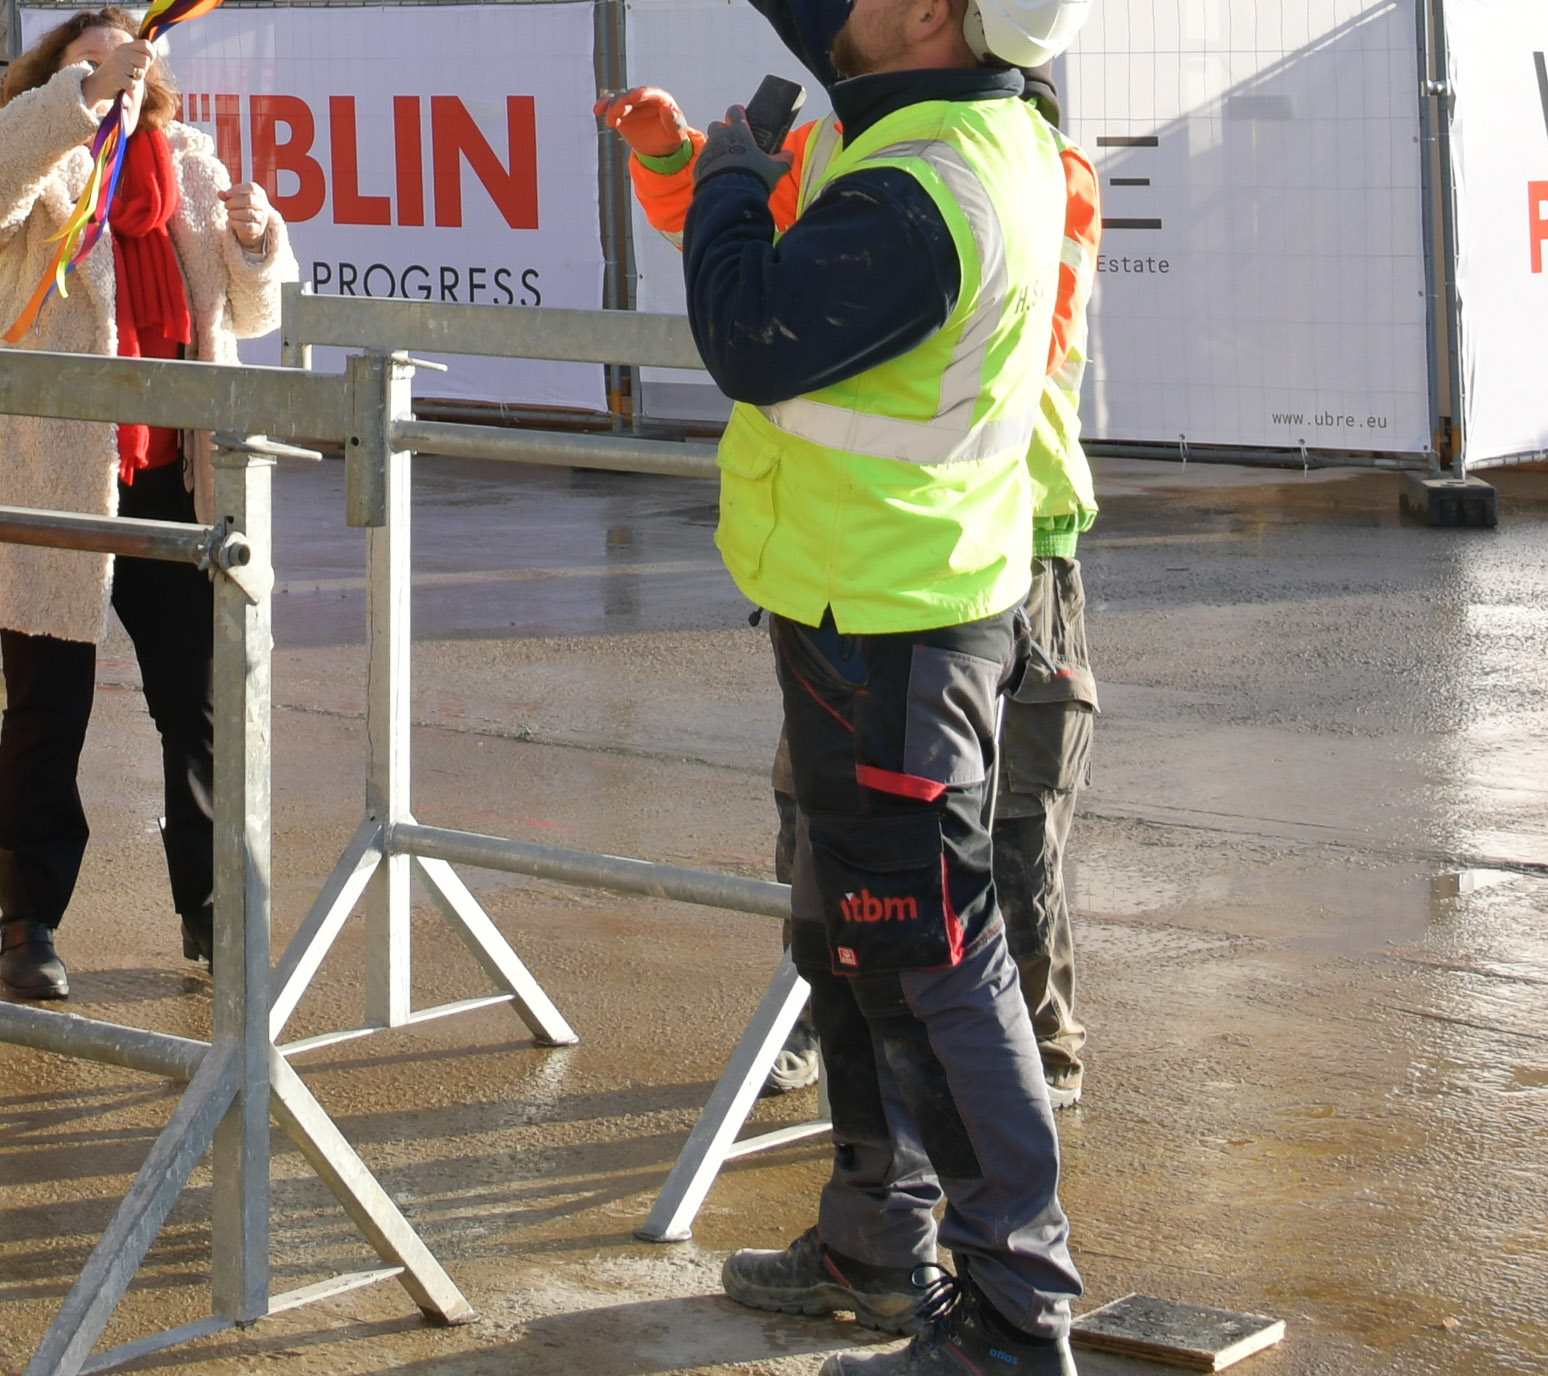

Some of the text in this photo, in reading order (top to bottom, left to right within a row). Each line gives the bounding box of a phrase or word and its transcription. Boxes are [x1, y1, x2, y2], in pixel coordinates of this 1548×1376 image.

[1096, 254, 1171, 274] Estate
[1271, 410, 1388, 429] www.ubre.eu
[989, 1348, 1020, 1366] atlas
